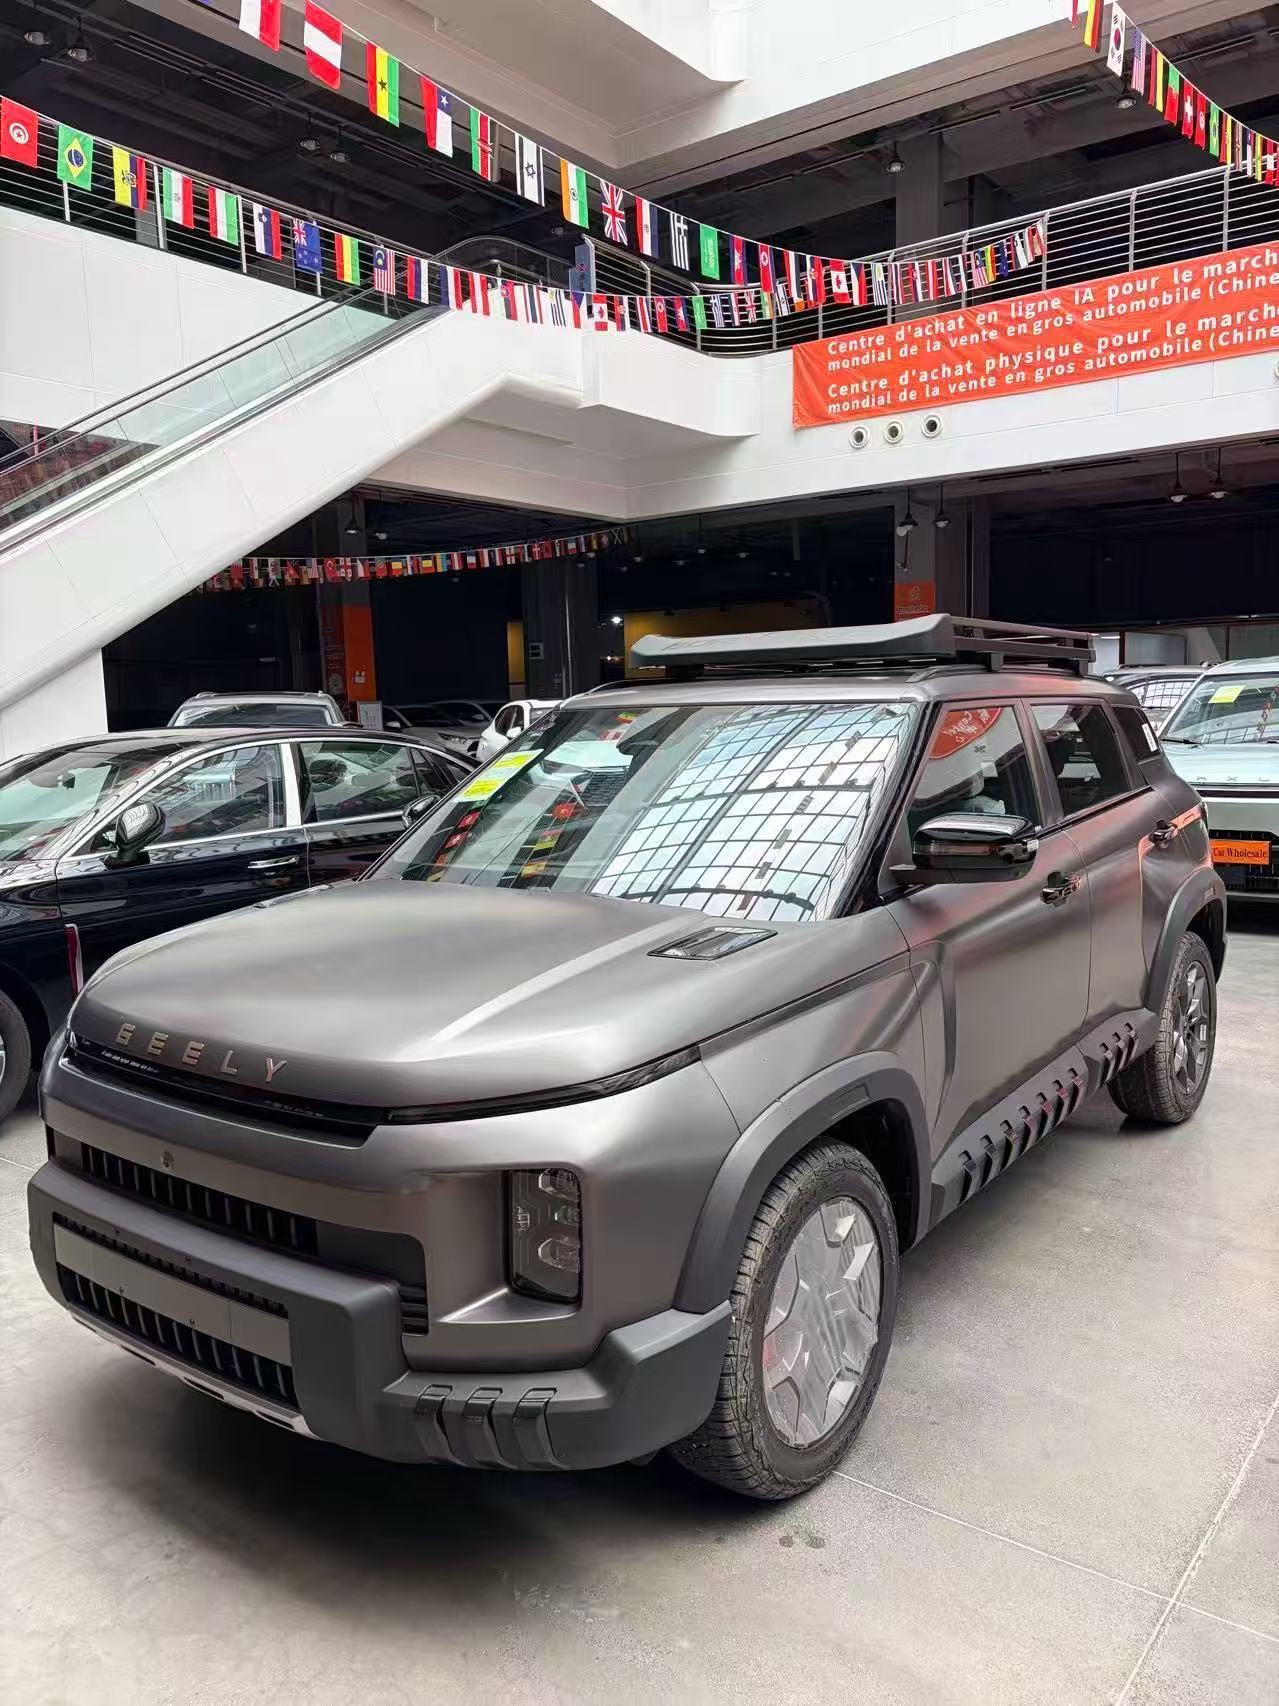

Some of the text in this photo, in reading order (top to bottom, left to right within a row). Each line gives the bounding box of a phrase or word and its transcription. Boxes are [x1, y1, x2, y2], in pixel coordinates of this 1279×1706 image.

[827, 334, 885, 355] Centre
[895, 315, 965, 342] d'achat
[976, 310, 998, 325] en
[1010, 297, 1061, 319] ligne
[1074, 288, 1094, 305] IA
[1108, 276, 1159, 302] pour
[1173, 268, 1193, 284] le
[827, 347, 892, 371] mondial
[900, 344, 918, 357] de
[926, 339, 941, 352] la
[949, 329, 998, 348] vente
[1083, 287, 1201, 322] automobile
[1209, 272, 1279, 300] (Chine
[828, 303, 1279, 398] Centre d'achat physique pour le march
[827, 325, 1279, 414] mondial de la vente en gros automobile (Chine
[1227, 846, 1267, 858] Wholesale
[115, 1022, 287, 1084] GEELY
